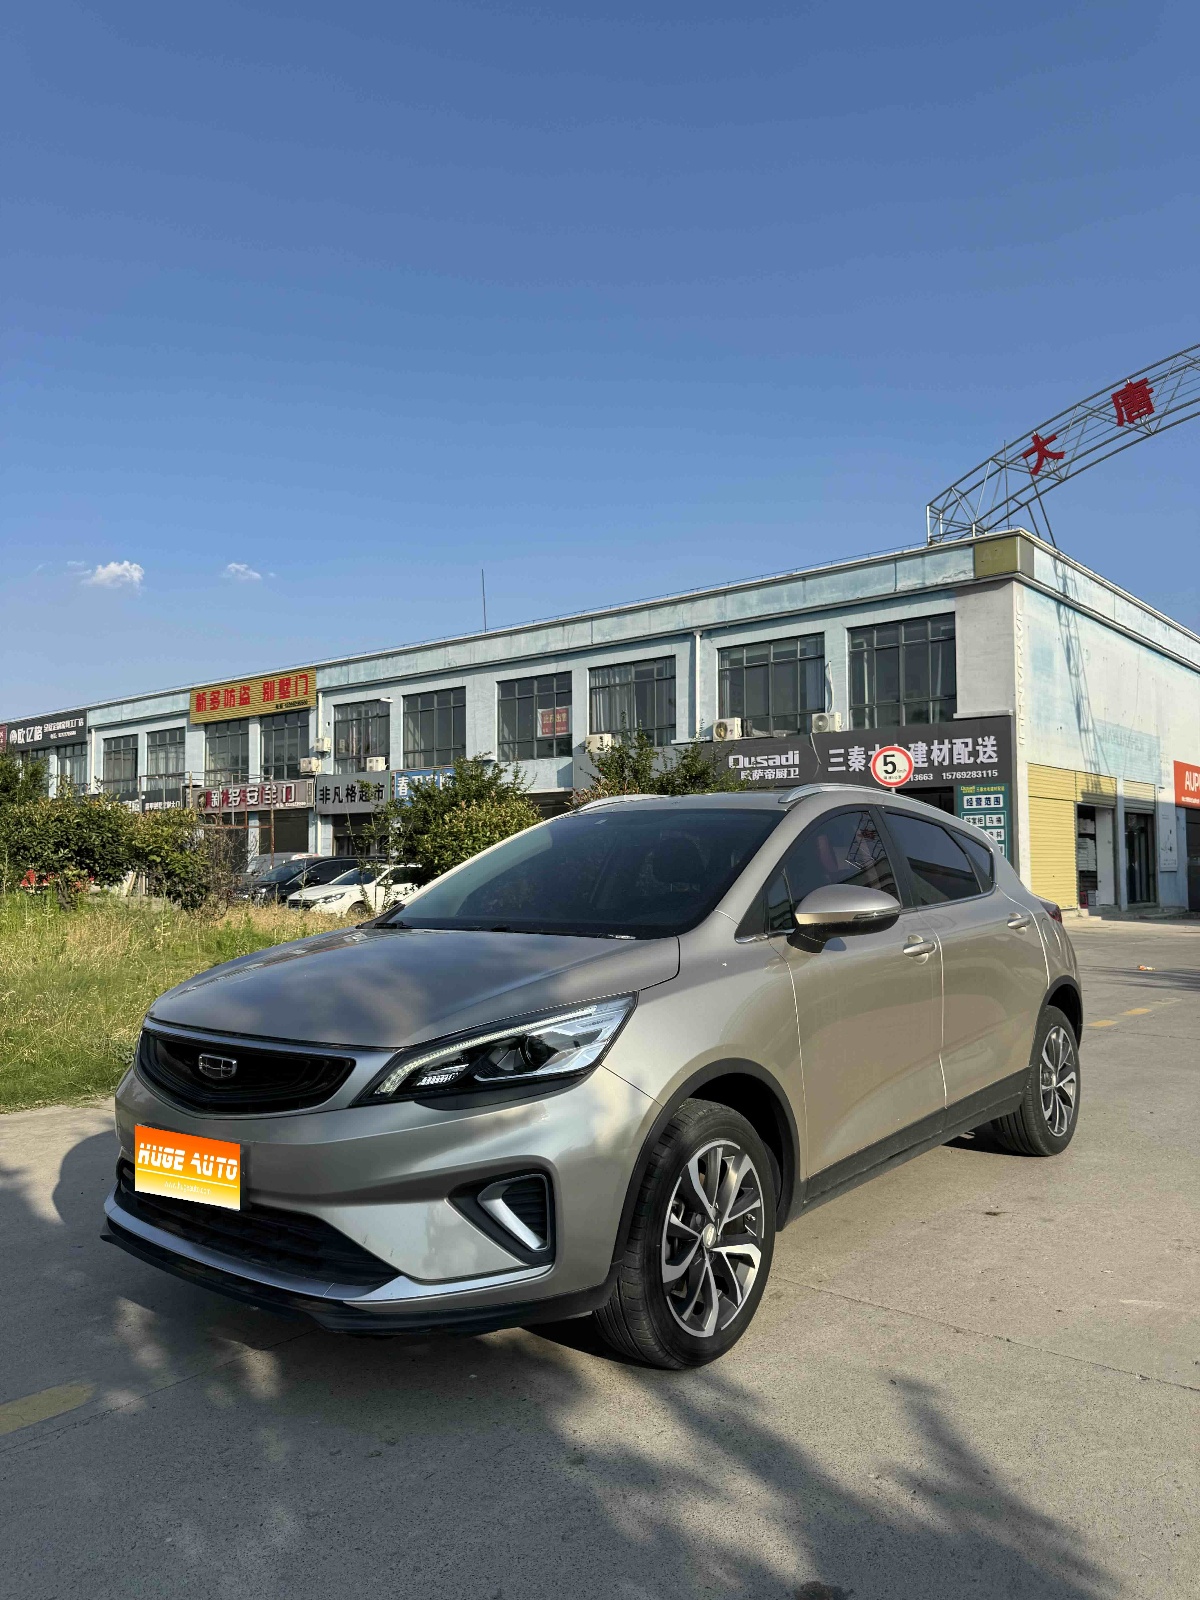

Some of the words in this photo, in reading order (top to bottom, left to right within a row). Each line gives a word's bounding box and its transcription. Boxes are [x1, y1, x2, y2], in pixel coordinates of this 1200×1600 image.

[195, 685, 250, 712] 新多防盗
[262, 673, 308, 702] 别墅门
[17, 725, 43, 744] 欧亿格
[827, 735, 999, 772] 三秦建材配送
[883, 754, 897, 774] 5
[740, 767, 800, 781] 欧萨帝厨卫
[907, 773, 933, 782] 13663
[941, 770, 998, 780] 15769283115
[211, 783, 296, 807] 新多安全门
[966, 796, 1001, 807] 经营范围
[987, 816, 1002, 825] 马桶
